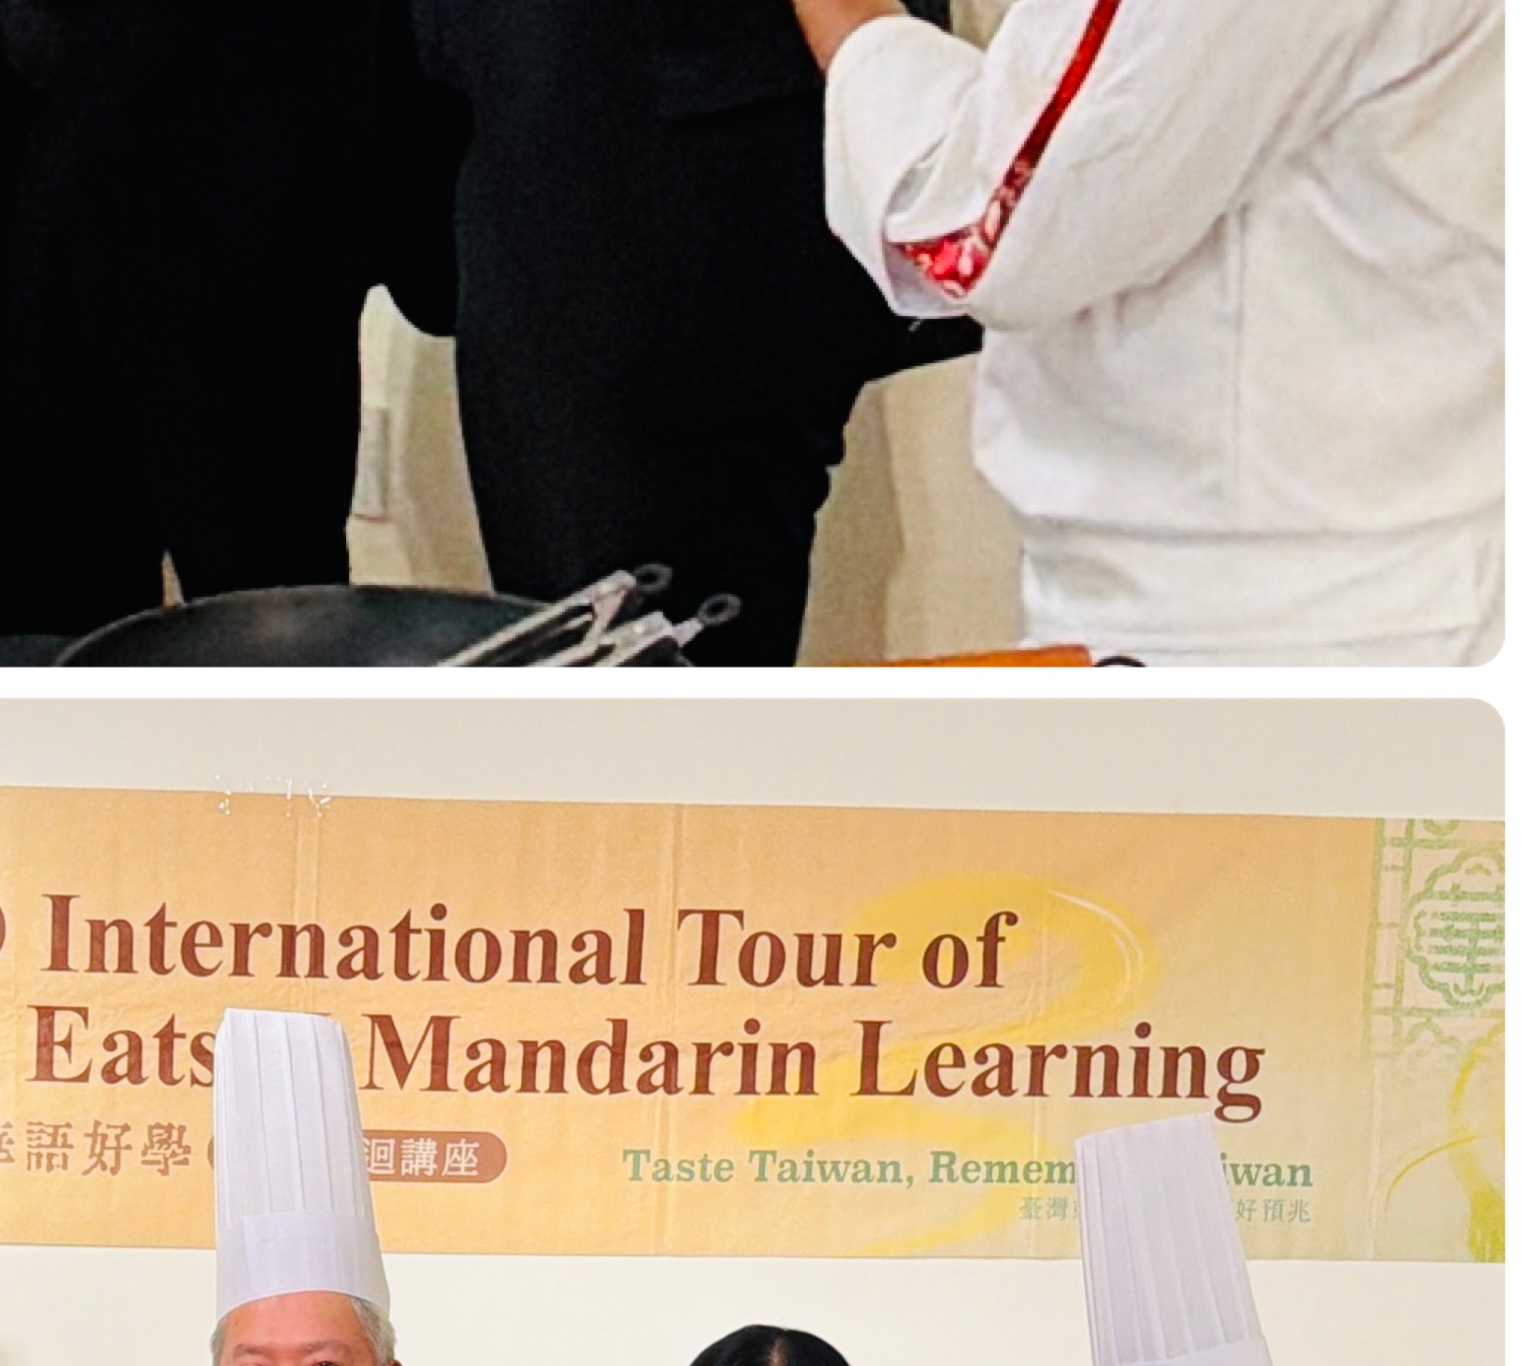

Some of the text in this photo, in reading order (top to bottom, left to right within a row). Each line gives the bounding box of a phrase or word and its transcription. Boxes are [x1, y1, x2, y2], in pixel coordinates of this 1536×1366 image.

[39, 893, 648, 987] International
[676, 908, 898, 989] Tour
[921, 910, 1020, 990] of
[24, 1003, 217, 1089] Eats
[360, 1012, 821, 1097] Mandarin
[849, 1018, 1267, 1124] Learning
[622, 1148, 1314, 1189] Taste Taiwan, Remem iwan
[1020, 1196, 1078, 1221] 臺灣
